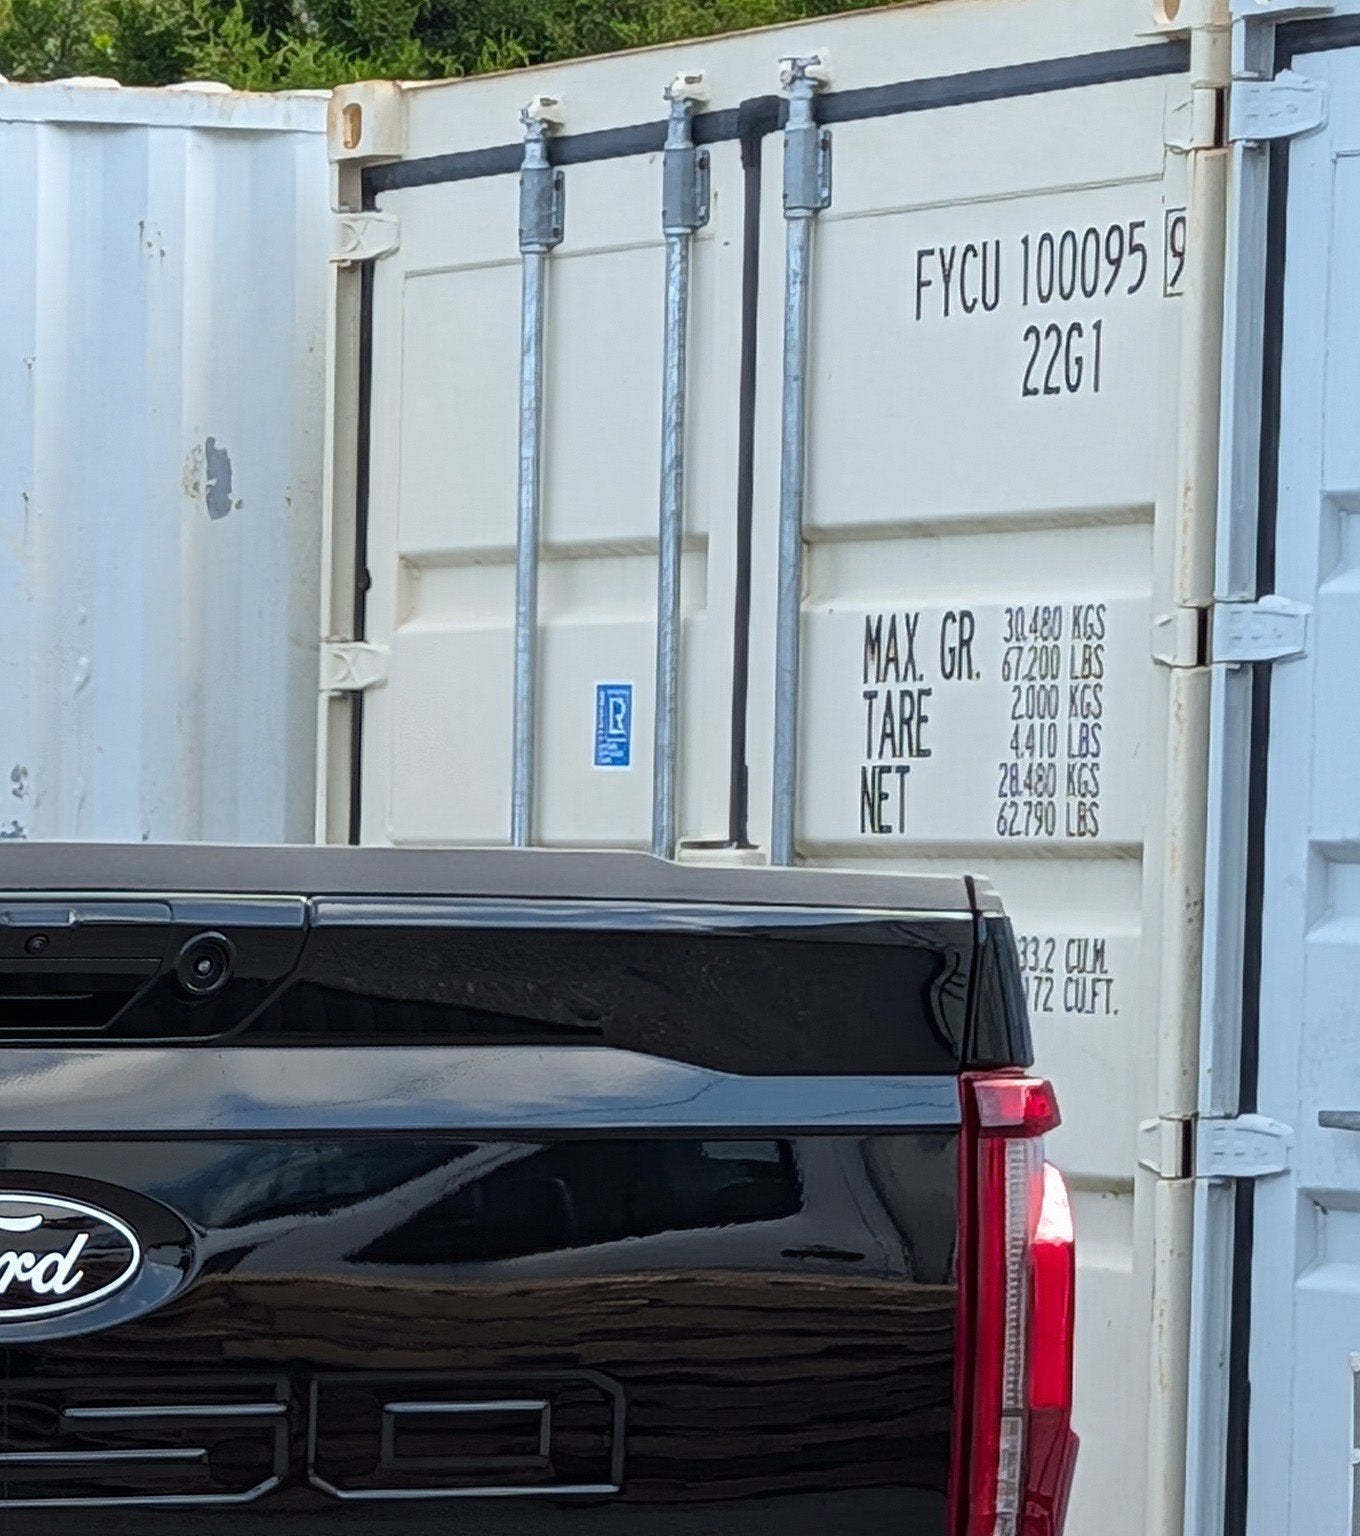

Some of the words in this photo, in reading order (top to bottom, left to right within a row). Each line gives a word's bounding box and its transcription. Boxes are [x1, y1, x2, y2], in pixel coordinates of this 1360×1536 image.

[914, 238, 1001, 321] FYCU
[1021, 220, 1147, 306] 100095
[1021, 319, 1102, 397] 22G1
[863, 611, 924, 684] MAX.
[940, 610, 981, 681] GR.
[1071, 603, 1107, 641] KGS
[1069, 643, 1105, 680] LBS
[863, 687, 932, 759] TARE
[1068, 682, 1103, 719] KGS
[1067, 722, 1102, 758] LBS
[860, 765, 910, 834] NET
[1066, 762, 1100, 798] KGS
[1065, 800, 1100, 837] LBS
